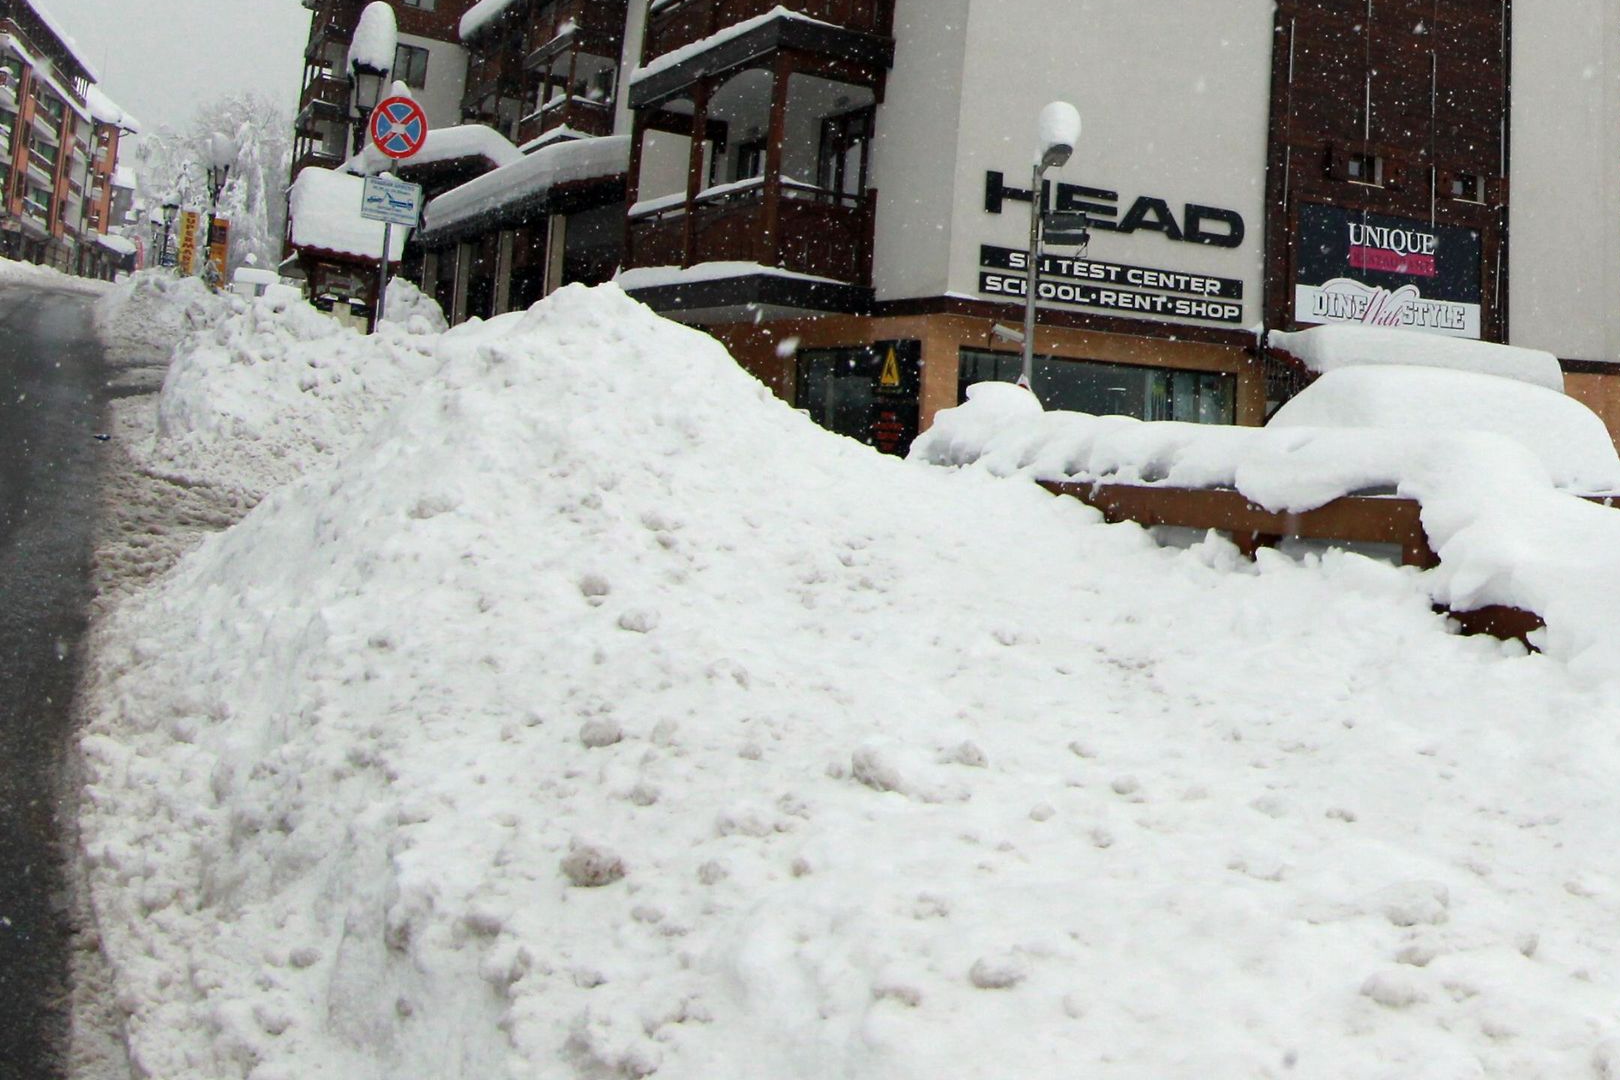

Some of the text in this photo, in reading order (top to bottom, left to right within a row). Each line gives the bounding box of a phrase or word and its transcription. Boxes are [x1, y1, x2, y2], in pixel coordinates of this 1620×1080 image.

[984, 170, 1245, 249] HEAD
[1347, 222, 1436, 257] UNIQUE
[1009, 252, 1221, 295] SI TEST CENTER
[1313, 291, 1368, 320] DINE
[1402, 301, 1466, 330] STYLE
